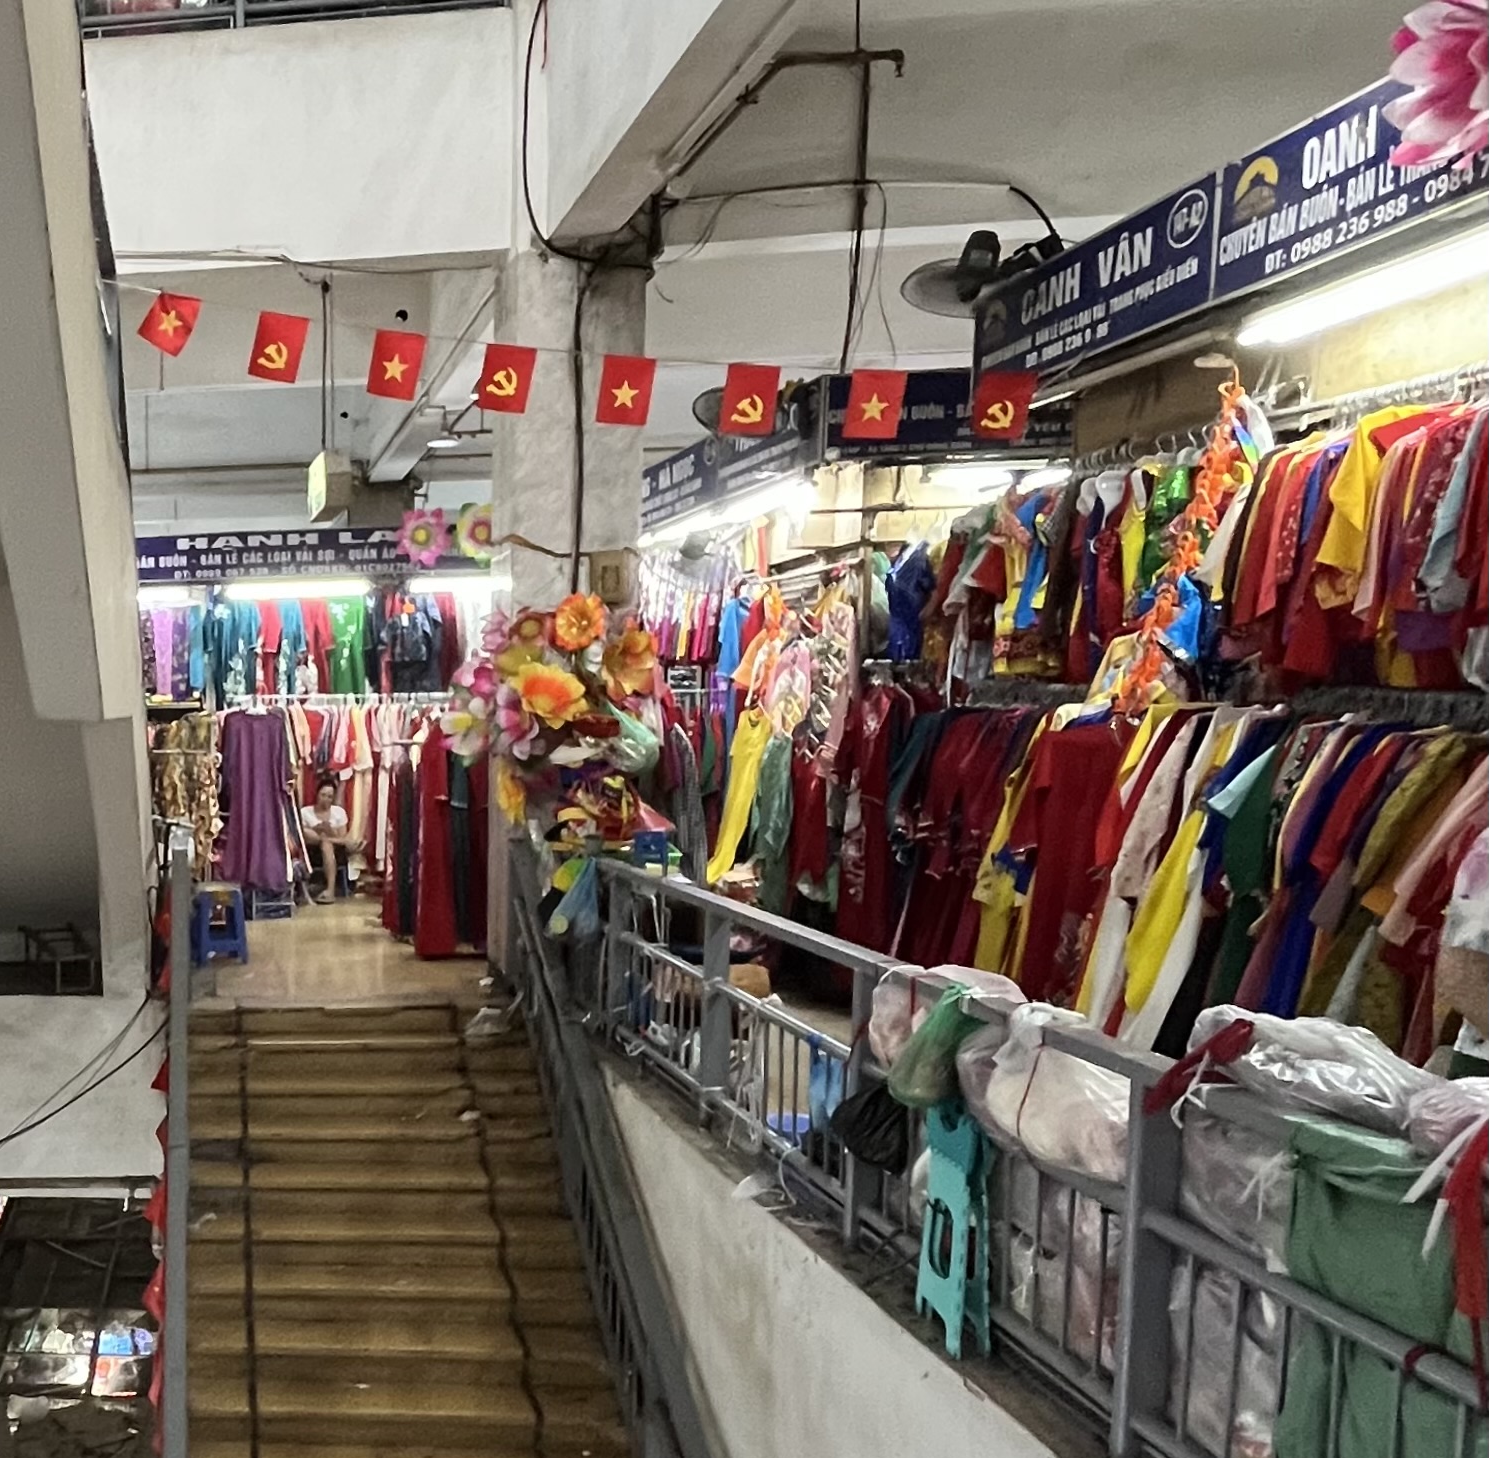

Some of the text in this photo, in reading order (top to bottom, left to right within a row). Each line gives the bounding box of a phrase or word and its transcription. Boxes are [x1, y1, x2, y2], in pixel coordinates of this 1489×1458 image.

[1098, 226, 1154, 289] VÂN
[1290, 228, 1333, 264] 0988
[1335, 210, 1371, 244] 236
[1373, 193, 1408, 228] 988
[176, 533, 320, 551] HẠNH
